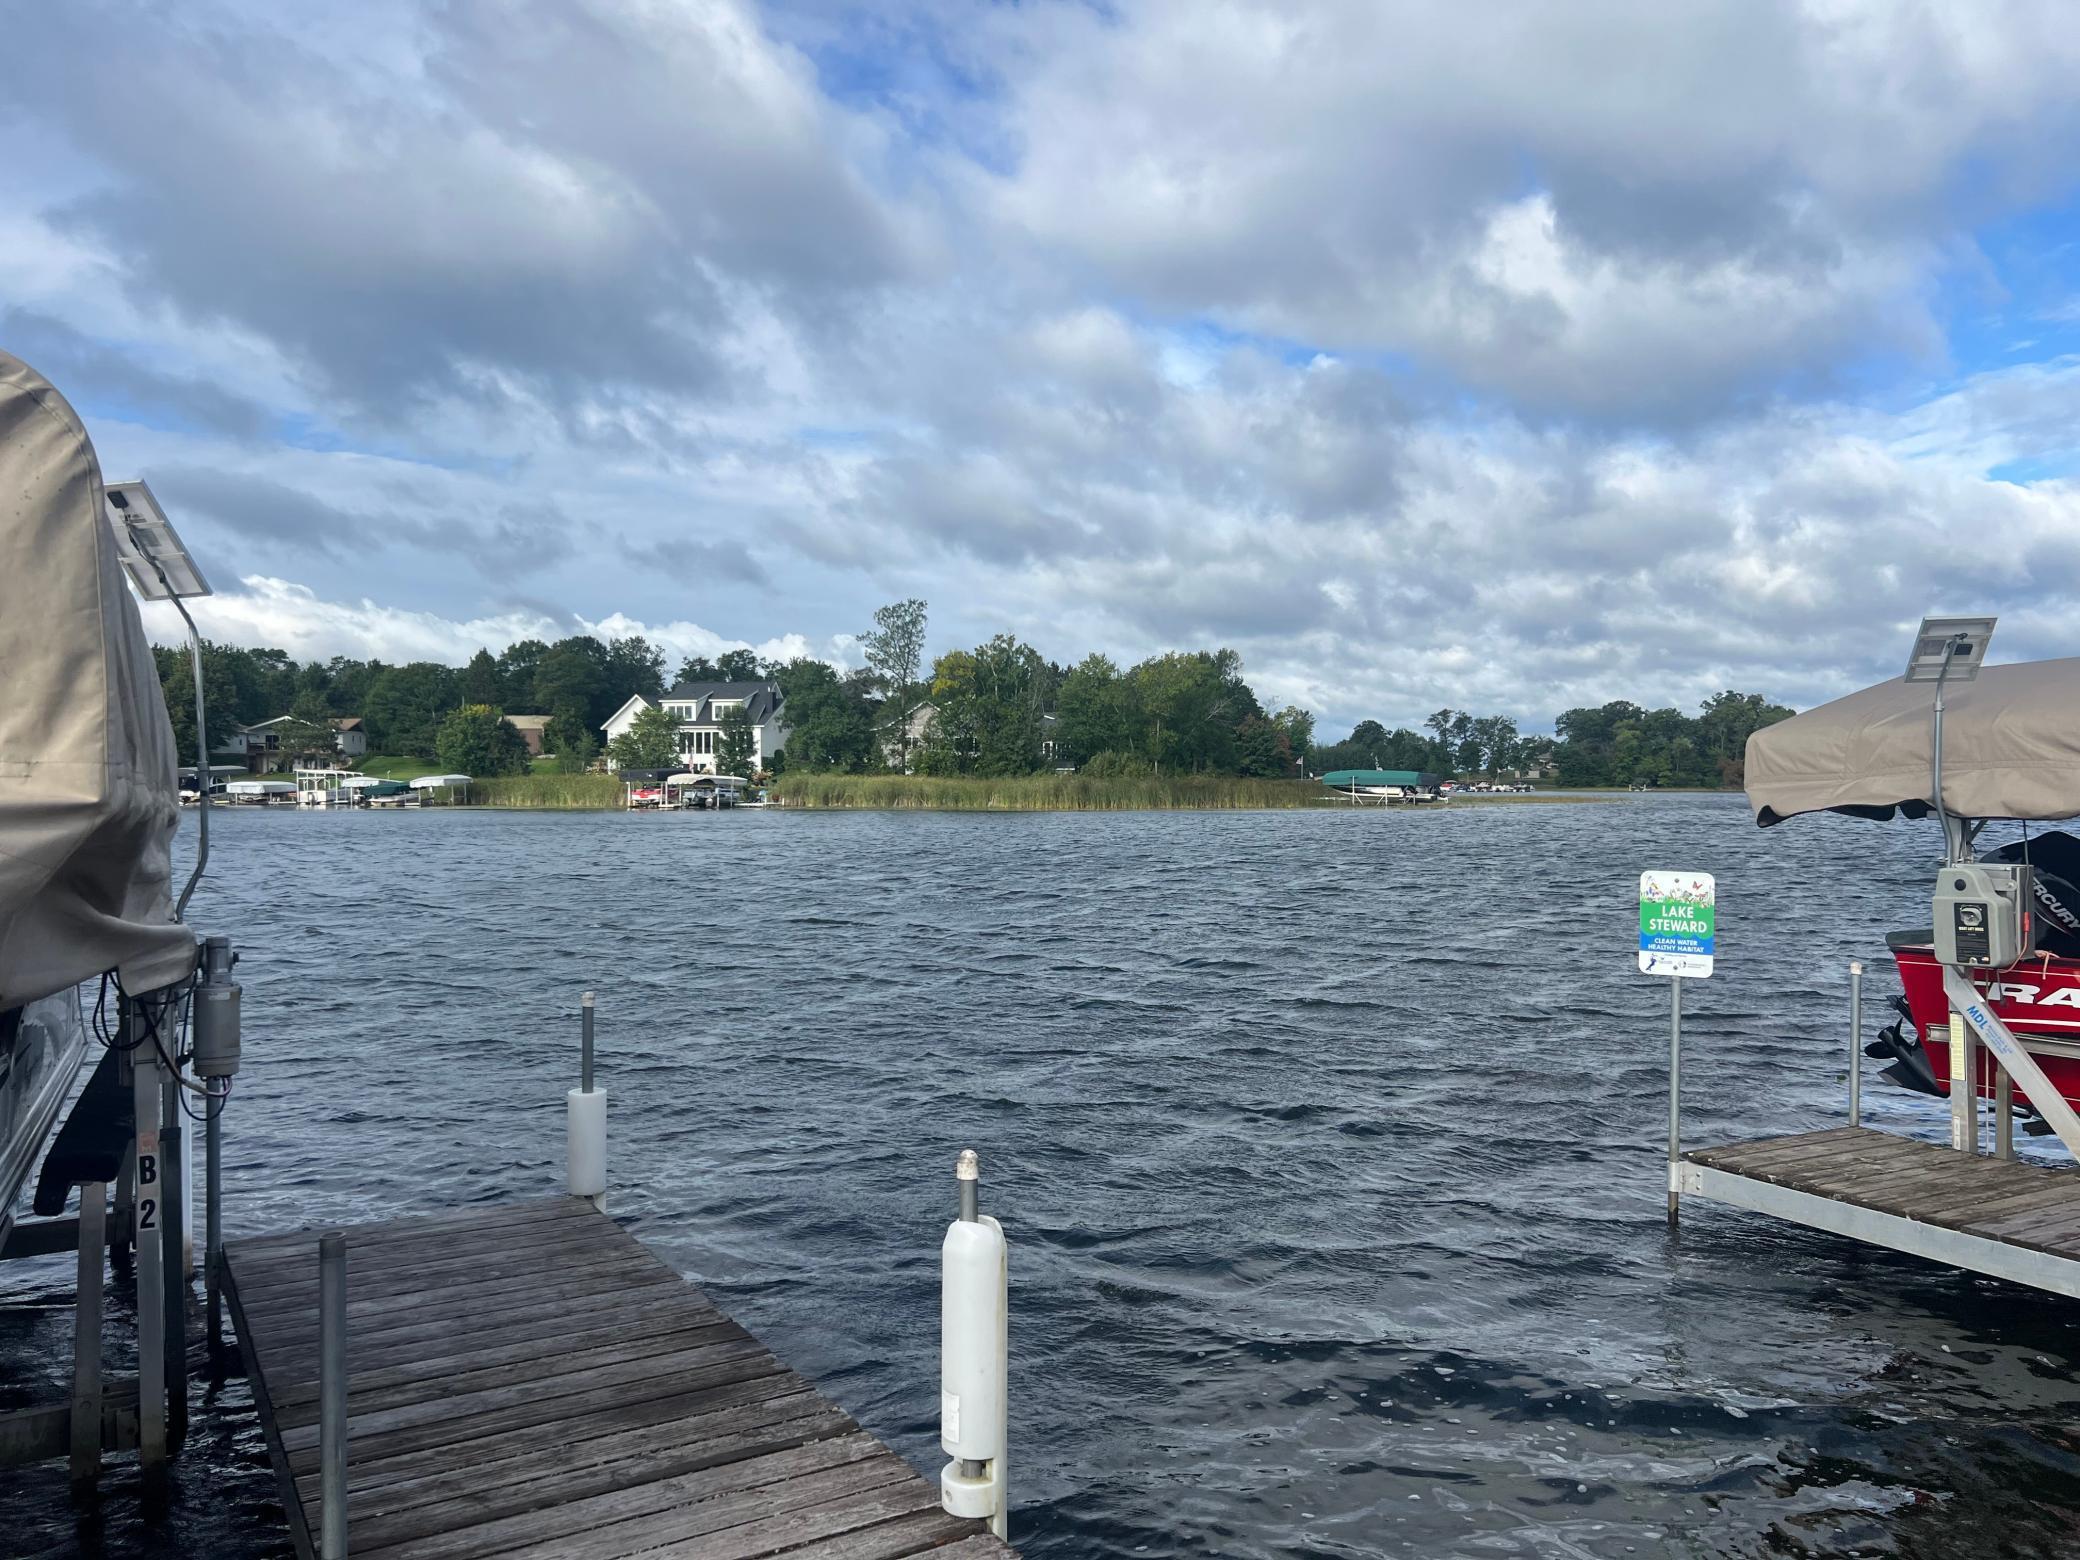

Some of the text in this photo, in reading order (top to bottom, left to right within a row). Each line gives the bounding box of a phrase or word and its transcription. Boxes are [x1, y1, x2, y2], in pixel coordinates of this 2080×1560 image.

[1662, 905, 1694, 918] LAKE
[1649, 919, 1707, 933] STEWARD
[1677, 945, 1705, 953] HABITAT
[1967, 1005, 1988, 1030] MDL
[139, 1155, 157, 1185] B
[139, 1198, 156, 1230] 2
